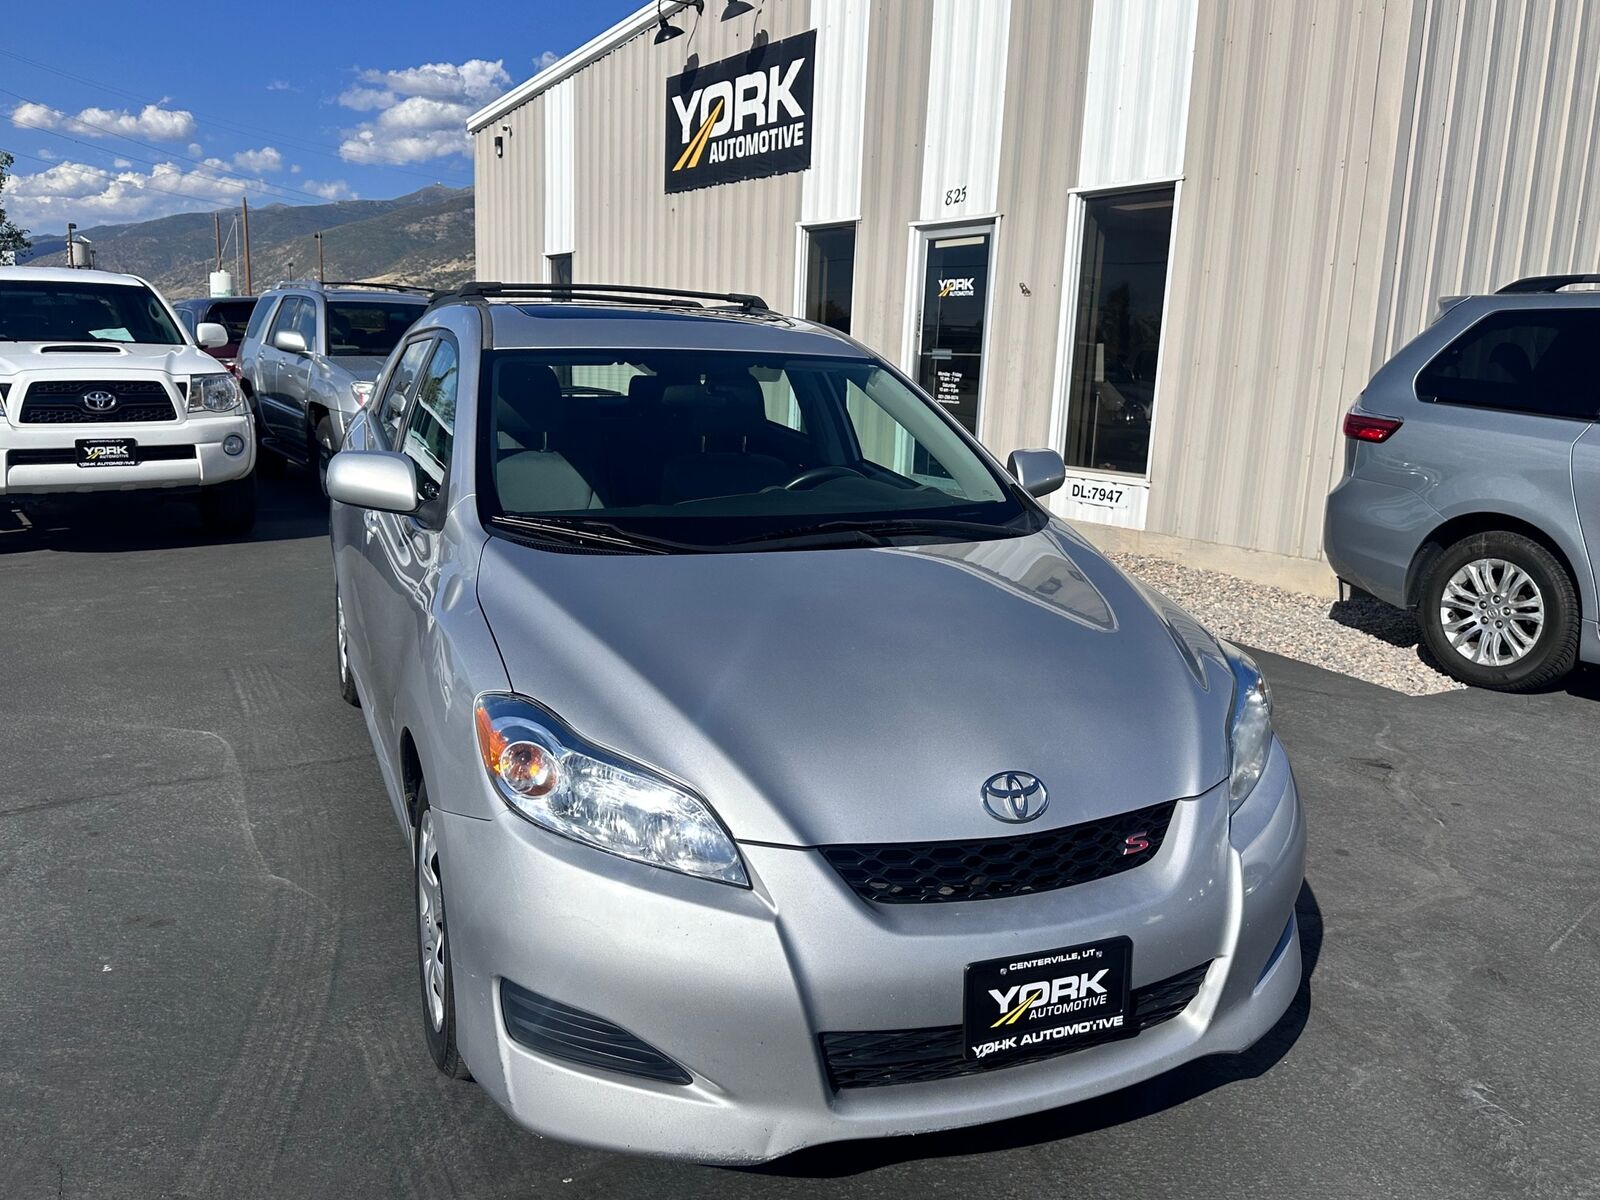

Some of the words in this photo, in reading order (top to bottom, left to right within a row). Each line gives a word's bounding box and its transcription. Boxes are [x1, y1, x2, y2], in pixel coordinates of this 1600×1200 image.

[671, 57, 806, 145] YORK
[708, 121, 805, 164] AUTOMOTIVE
[945, 184, 967, 206] 825
[938, 277, 975, 291] YORK
[83, 446, 128, 456] YORK
[1072, 484, 1123, 503] DL:7947
[1123, 831, 1149, 855] S
[1009, 955, 1081, 971] CENTERVILLE,
[1082, 949, 1096, 957] UT
[988, 968, 1110, 1014] YORK
[1028, 994, 1107, 1020] AUTOMOTIVE
[1020, 1015, 1124, 1046] AUTOMOTIVE
